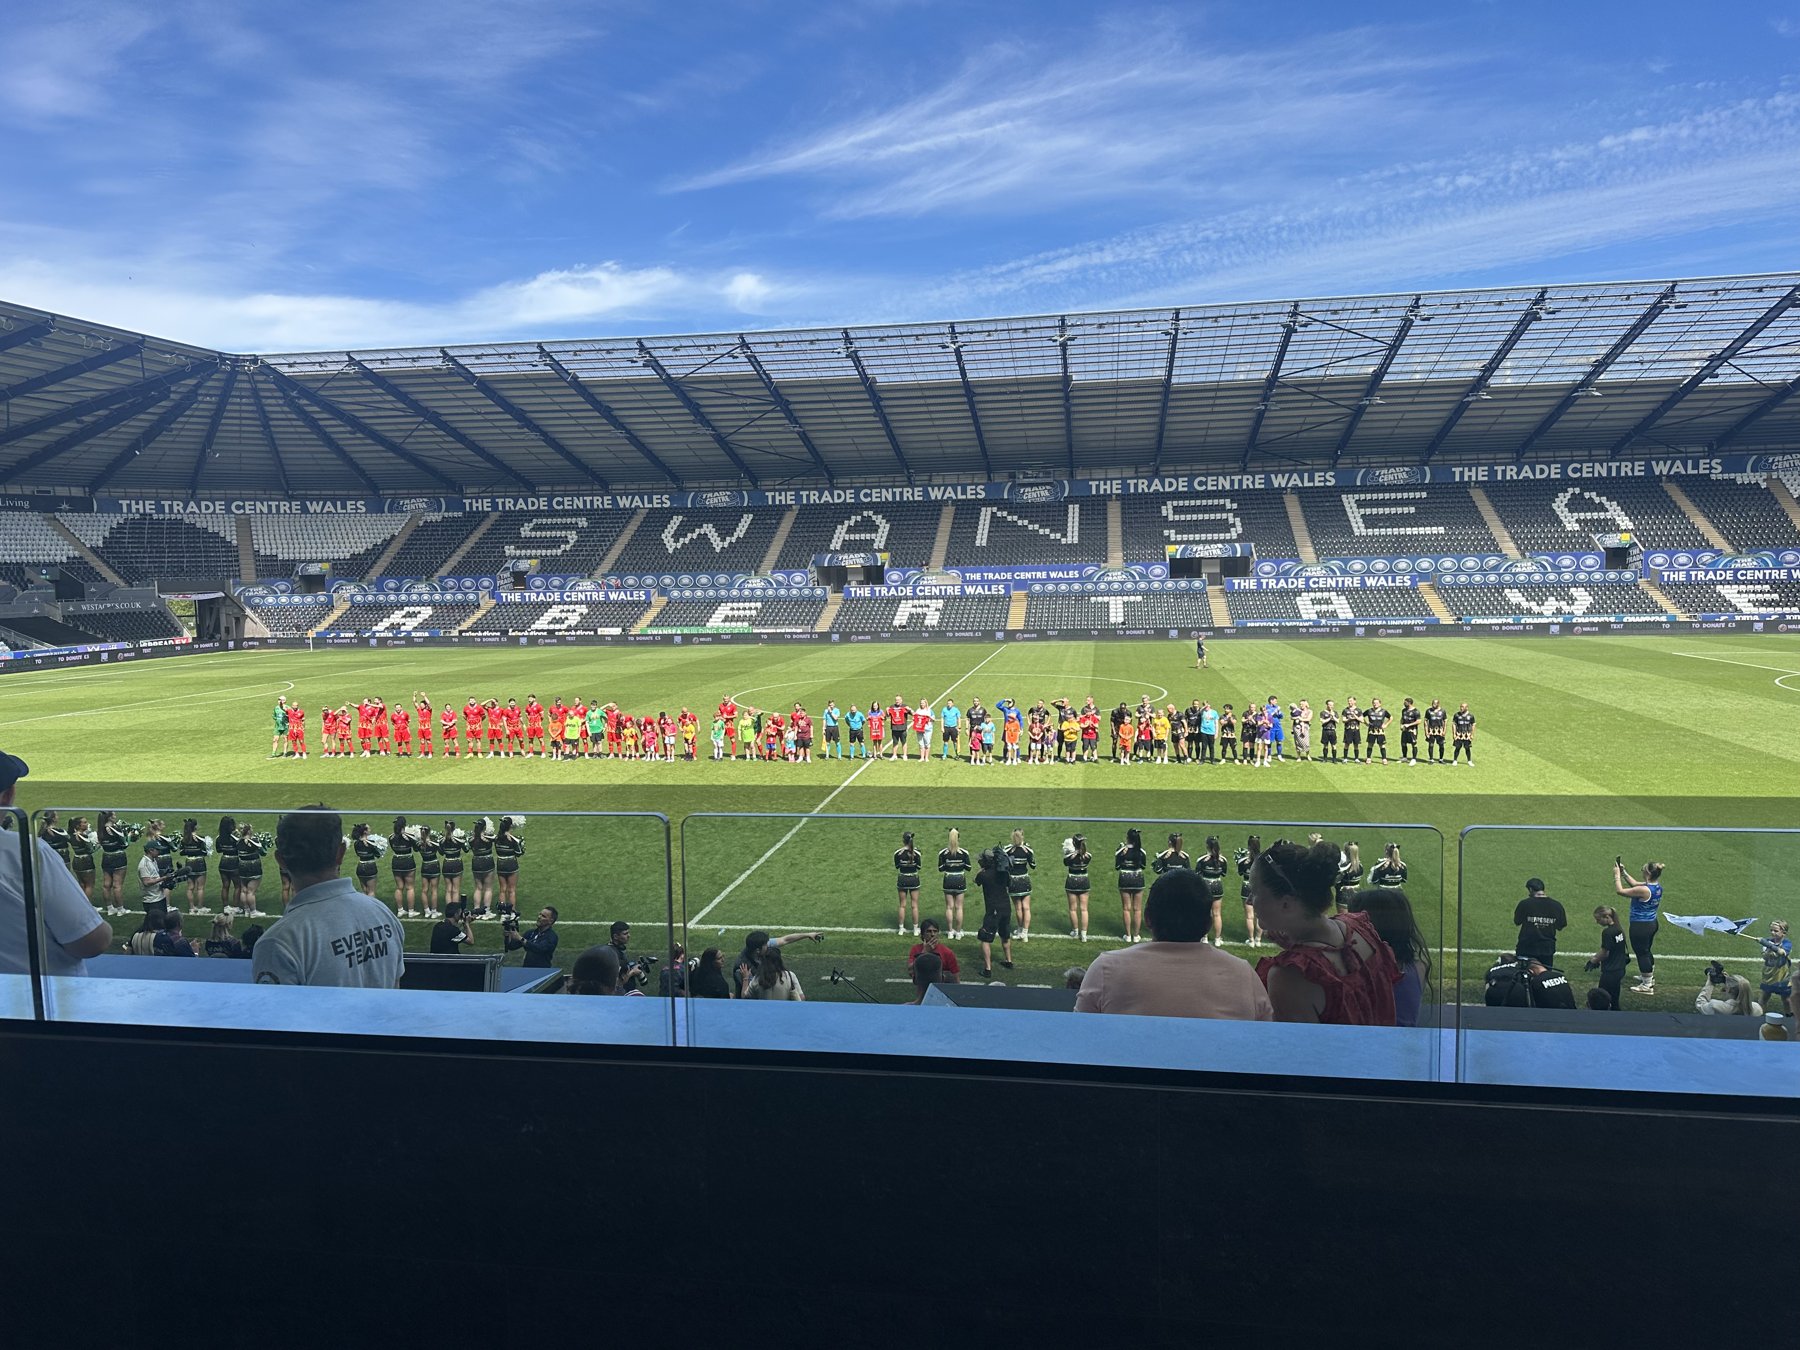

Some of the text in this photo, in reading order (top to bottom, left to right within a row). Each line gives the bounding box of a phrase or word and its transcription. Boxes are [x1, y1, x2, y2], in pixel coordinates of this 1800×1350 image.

[1768, 454, 1800, 463] TRAD
[1772, 460, 1800, 470] CENTR
[1452, 459, 1724, 481] THE TRADE CENTRE WALES
[1089, 472, 1335, 494] THE TRADE CENTRE WALES
[765, 485, 985, 504] THE TRADE CENTRE WALES
[0, 498, 30, 509] Living
[119, 500, 368, 515] THE TRADE CENTRE WALES
[463, 495, 670, 511] THE TRADE CENTRE WALES
[1662, 571, 1686, 581] THE
[1690, 571, 1733, 580] TRADE
[1737, 570, 1787, 579] CENTRE
[1233, 576, 1411, 590] THE TRADE CENTRE WALES
[501, 591, 645, 602] THE TRADE CENTRE WALES
[850, 585, 1005, 597] THE TRADE CENTRE WALES
[872, 721, 879, 730] 17
[330, 924, 392, 956] EVENTS
[345, 941, 388, 968] TEAM
